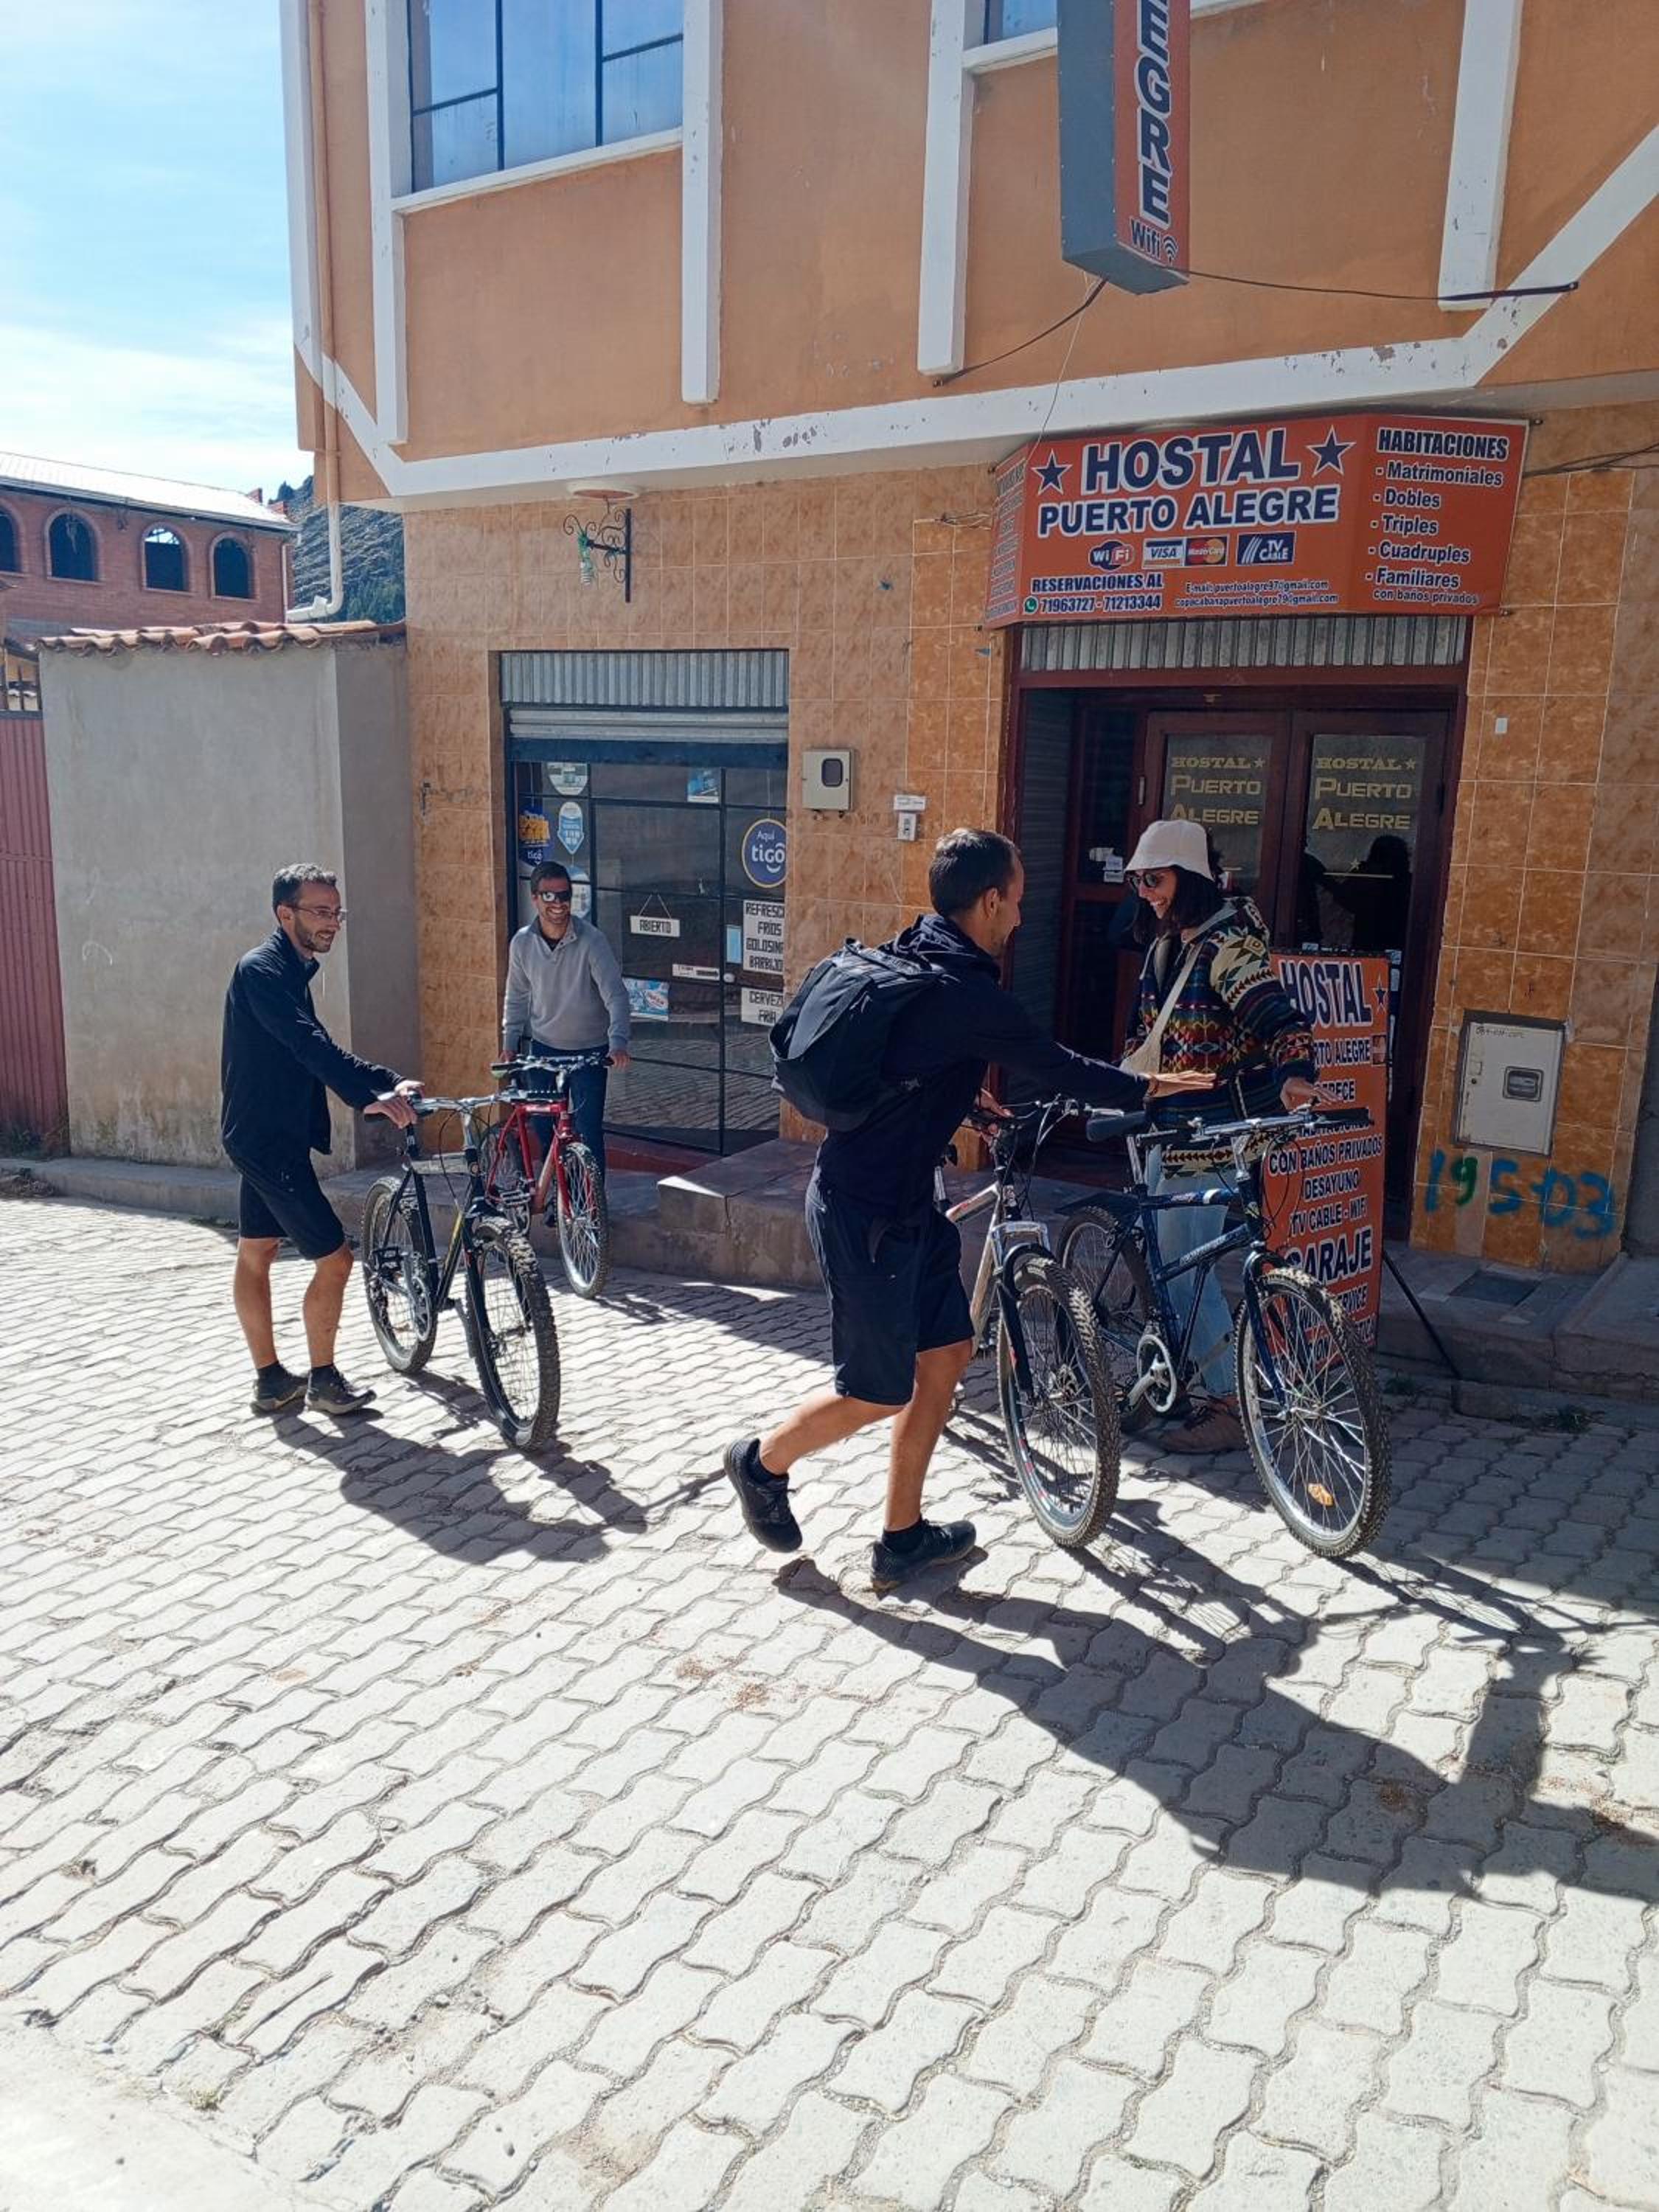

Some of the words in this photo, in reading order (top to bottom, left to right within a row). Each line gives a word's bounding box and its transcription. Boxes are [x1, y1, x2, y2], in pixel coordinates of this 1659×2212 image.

[1136, 0, 1172, 227] EGRE
[1130, 218, 1161, 259] Wifi
[1377, 428, 1509, 459] HABITACIONES
[1082, 428, 1300, 494] HOSTAL
[1388, 462, 1503, 486] Matrimoniales
[1385, 488, 1440, 508] Dobles
[1039, 495, 1177, 537] PUERTO
[1185, 485, 1340, 528] ALEGRE
[1382, 514, 1437, 535] Triples
[1150, 547, 1178, 558] VISA
[1259, 547, 1289, 560] CABLE
[1267, 539, 1284, 552] TV
[1380, 540, 1470, 564] Cuadruples
[1032, 574, 1144, 593] RESERVACIONES
[1145, 572, 1164, 588] AL
[1377, 567, 1460, 588] Familiares
[1040, 596, 1095, 613] 71963727
[1105, 594, 1161, 611] 71213344
[1374, 589, 1394, 600] con
[1397, 589, 1429, 602] baños
[1432, 592, 1478, 606] privados
[1171, 757, 1251, 769] HOSTAL
[1315, 757, 1401, 771] HOSTAL
[1171, 774, 1262, 796] PUERTO
[1315, 776, 1413, 800] PUERTO
[1312, 807, 1411, 831] ALEGRE
[746, 902, 785, 919] REFRESC
[639, 919, 672, 934] ABIERTO
[749, 990, 783, 1007] CERVEZ
[1279, 960, 1373, 1027] HOSTAL
[1334, 1039, 1370, 1064] ALEGRE
[1268, 1151, 1298, 1176] CON
[1299, 1141, 1337, 1171] BAÑOS
[1338, 1133, 1383, 1164] PRIVADOS
[1303, 1169, 1360, 1202] DESAYUNO
[1292, 1210, 1307, 1237] TV
[1309, 1202, 1343, 1233] CABLE
